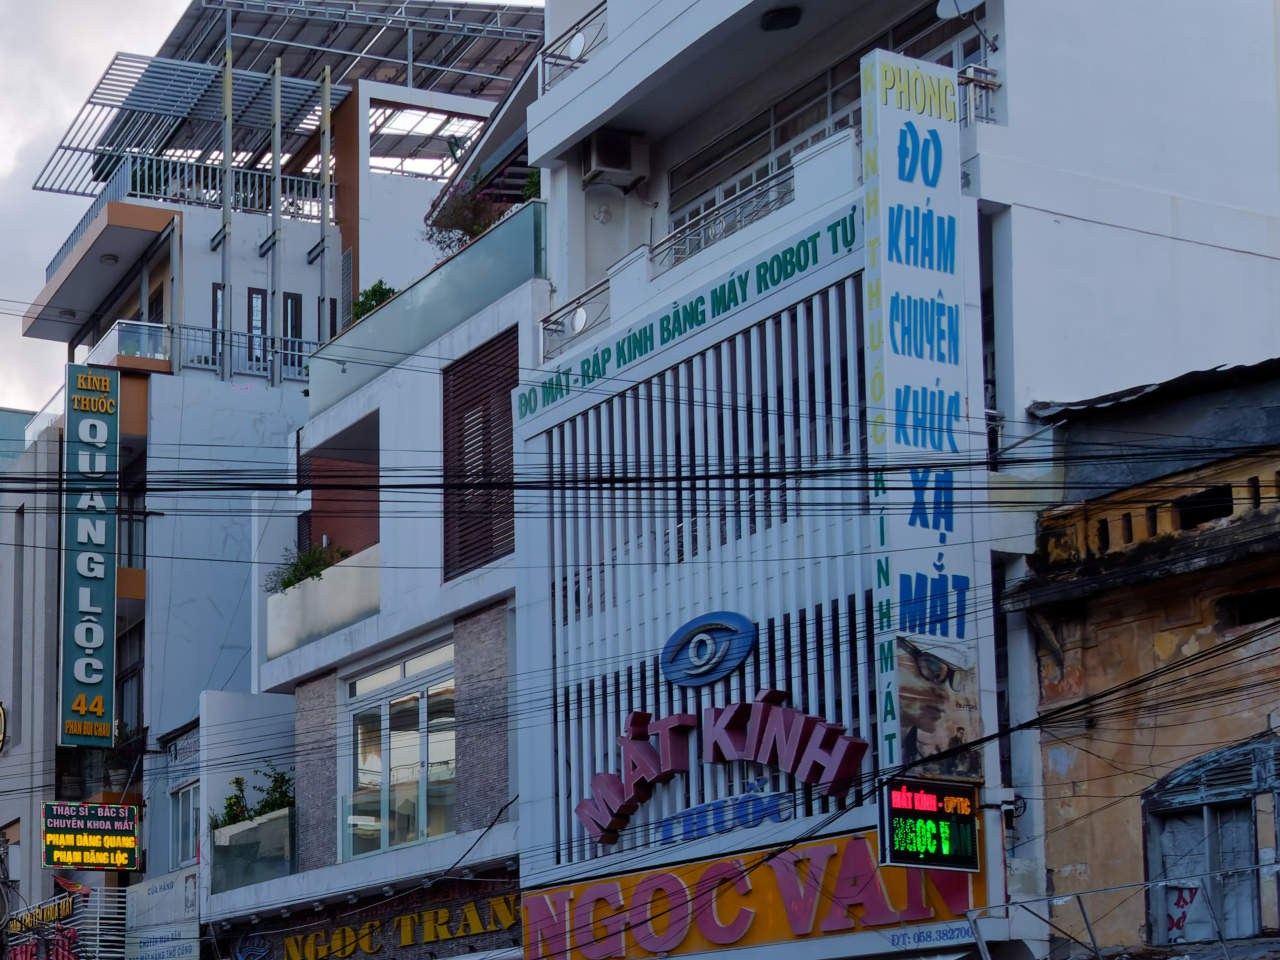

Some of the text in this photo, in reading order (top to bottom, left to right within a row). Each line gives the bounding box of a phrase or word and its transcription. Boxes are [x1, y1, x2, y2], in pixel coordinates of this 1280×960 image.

[880, 62, 956, 122] PHÒNG
[898, 121, 942, 187] ĐO
[888, 197, 956, 274] KHÁM
[518, 384, 538, 419] ĐO
[617, 323, 654, 368] KÍNH
[660, 295, 705, 346] BẰNG
[711, 270, 750, 318] MÁY
[756, 232, 820, 294] ROBOT
[827, 205, 857, 254] TỰ
[890, 289, 959, 366] CHUYÊN
[71, 393, 116, 415] THUỐC
[75, 369, 111, 394] KÍNH
[895, 377, 960, 453] KHÚC
[908, 467, 953, 544] XẠ
[899, 552, 970, 639] MẮT
[71, 693, 105, 718] 44
[703, 689, 868, 798] KÍNH
[47, 818, 84, 829] CHUYÊN
[86, 820, 111, 830] KHOA
[52, 805, 76, 817] THẠC
[97, 805, 116, 817] BÁC
[103, 836, 135, 849] QUANG
[655, 776, 793, 845] THUỐC
[393, 894, 523, 947] TRAN
